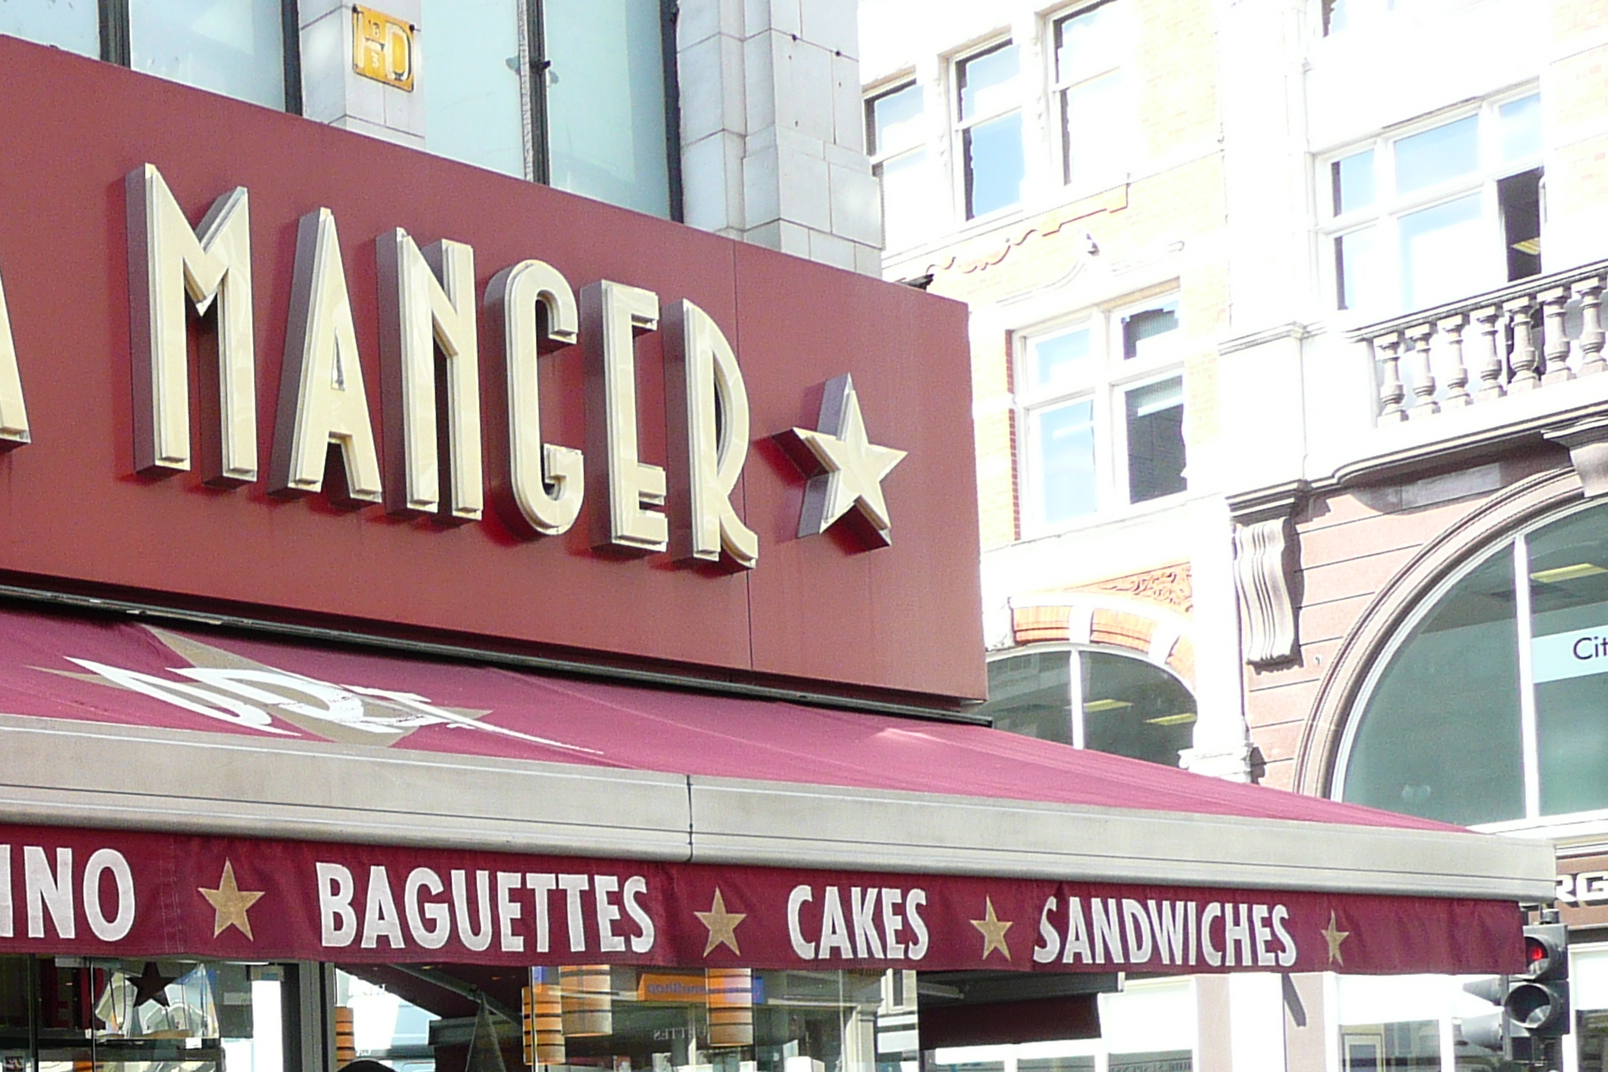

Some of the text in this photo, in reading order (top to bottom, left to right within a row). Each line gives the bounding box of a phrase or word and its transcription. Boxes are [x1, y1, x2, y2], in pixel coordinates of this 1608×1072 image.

[125, 163, 759, 574] MANGER
[315, 861, 655, 953] BAGUETTES
[787, 883, 930, 962] CAKES
[1032, 895, 1298, 968] SANDWICHES
